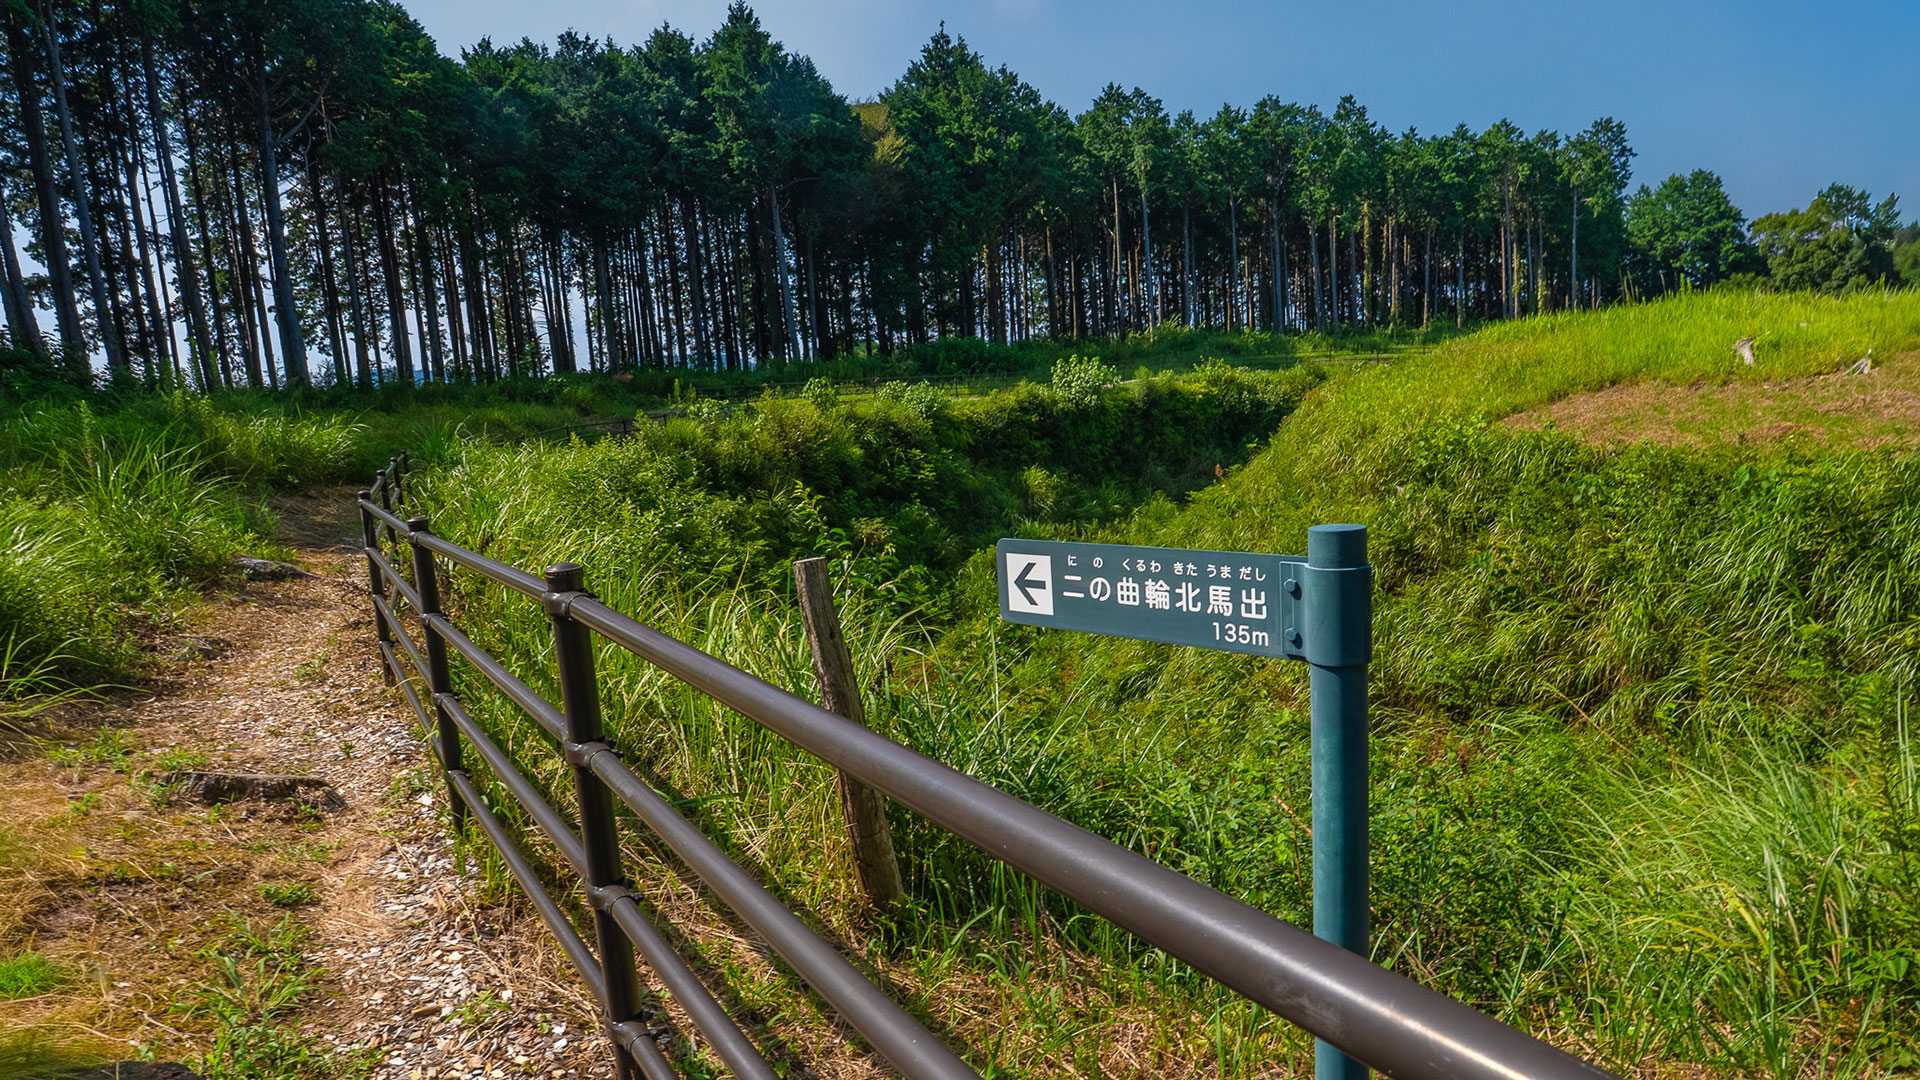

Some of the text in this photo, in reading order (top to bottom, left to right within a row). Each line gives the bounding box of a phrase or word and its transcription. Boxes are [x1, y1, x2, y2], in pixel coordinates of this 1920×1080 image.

[1062, 574, 1268, 620] 二の曲輪北馬出
[1212, 621, 1269, 647] 135m
